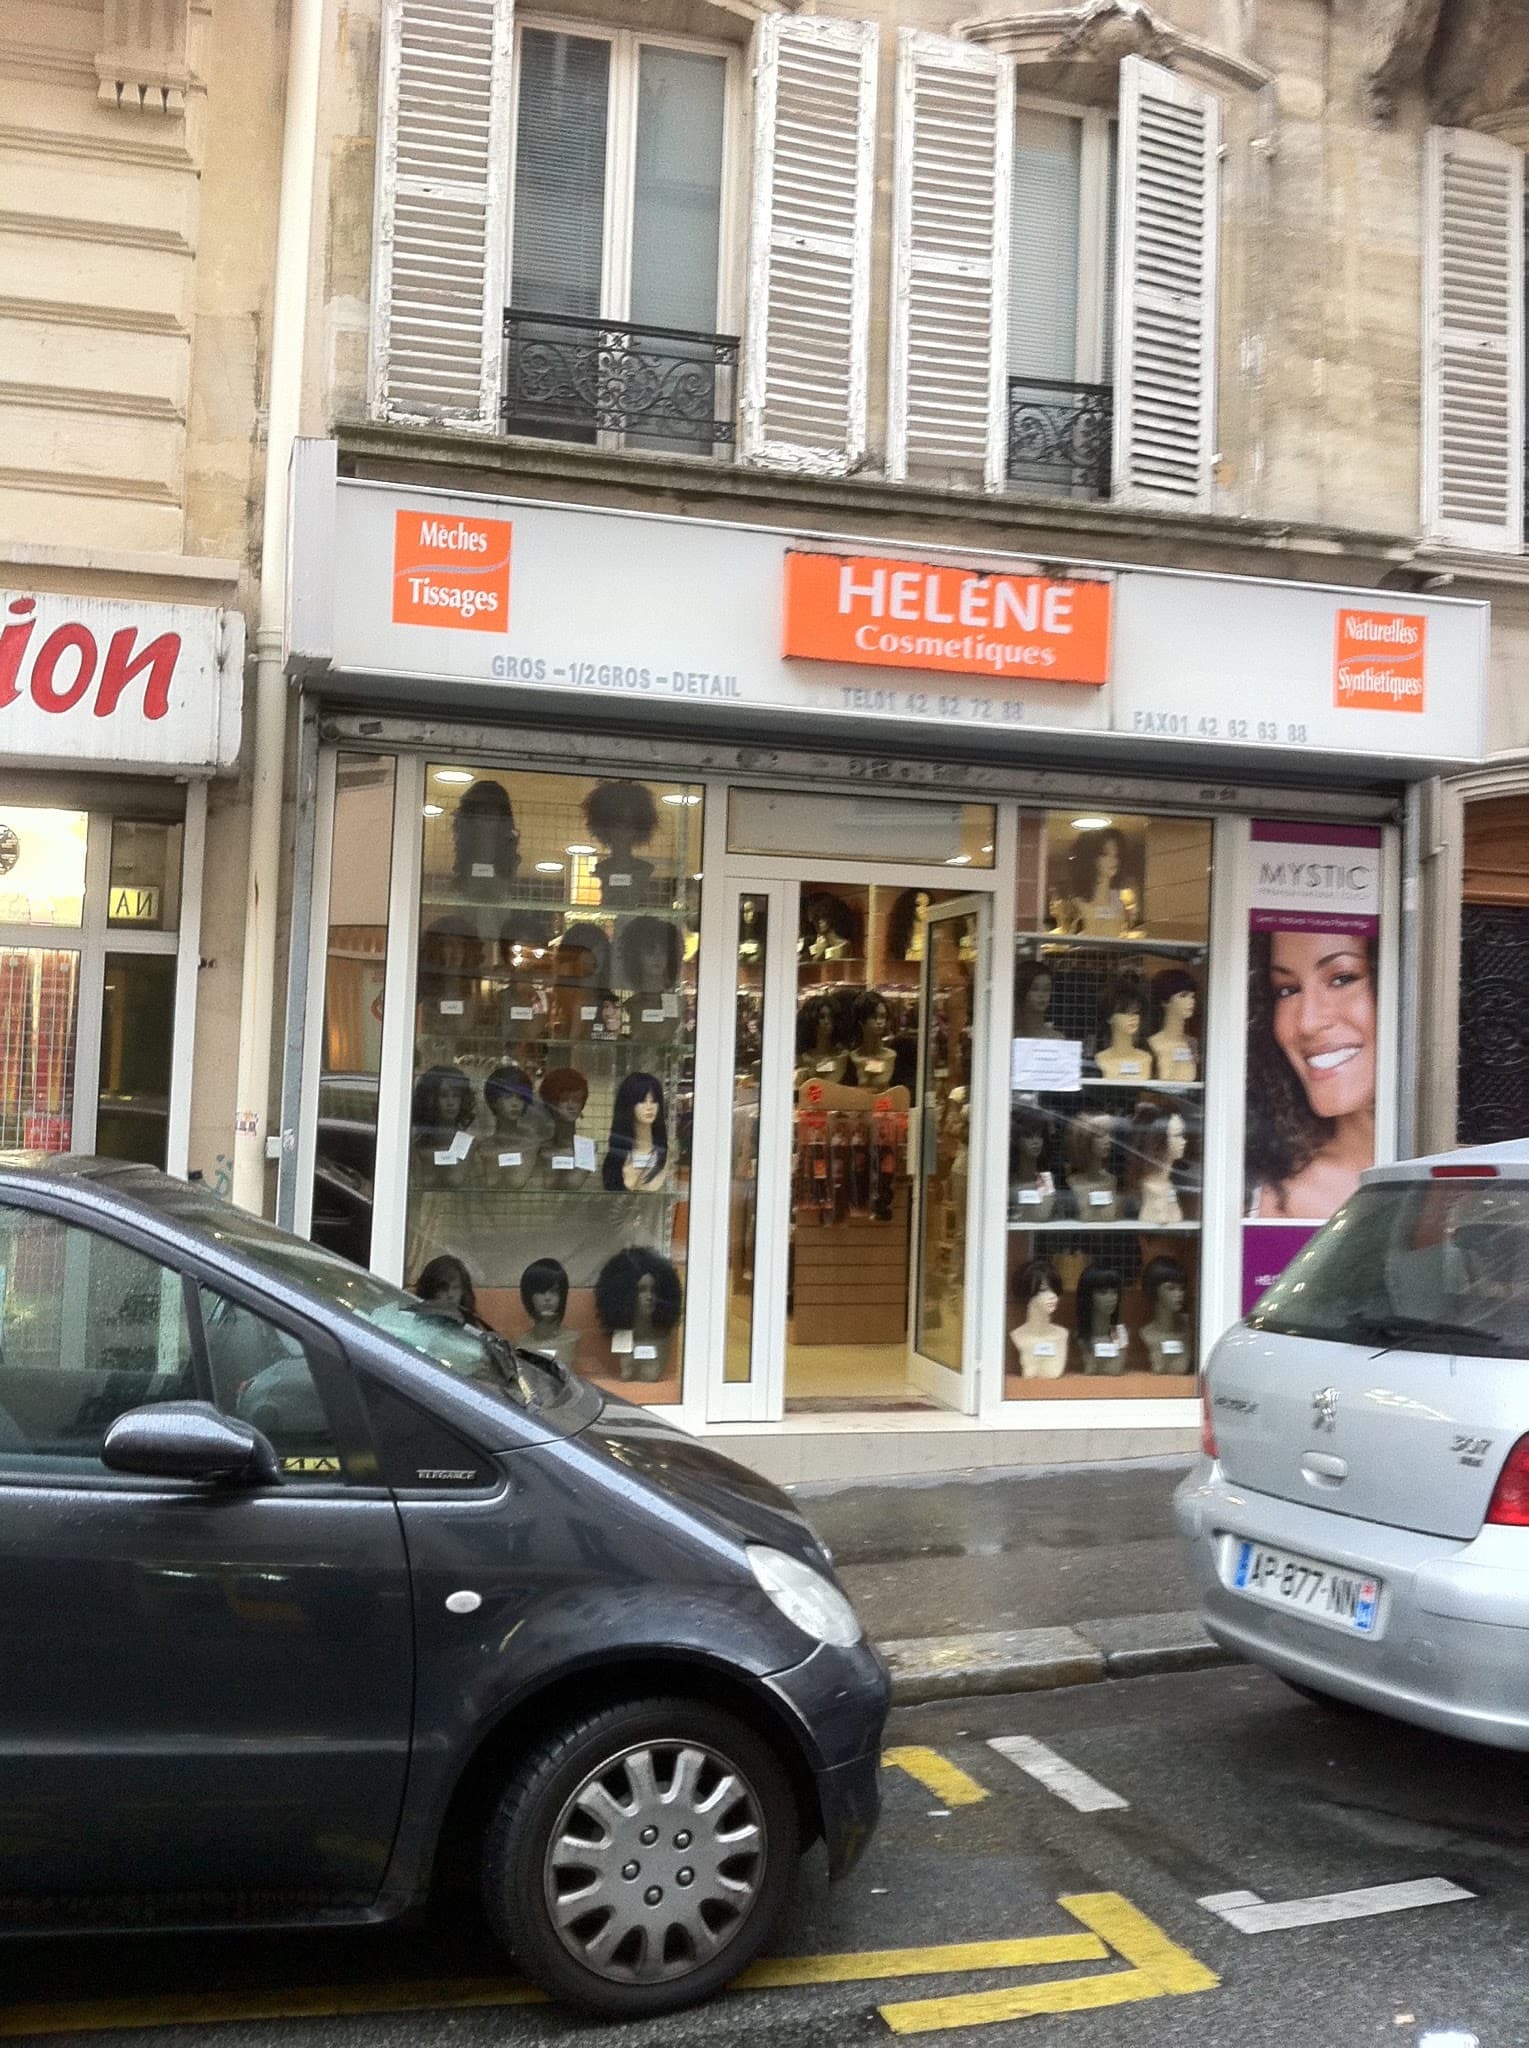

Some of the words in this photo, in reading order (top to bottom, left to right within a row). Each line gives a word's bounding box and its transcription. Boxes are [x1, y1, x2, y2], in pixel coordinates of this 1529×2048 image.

[408, 577, 498, 618] Tissages
[855, 624, 1057, 670] Cosmetiques
[1345, 616, 1418, 644] Naturelles
[492, 655, 546, 680] GROS
[673, 671, 742, 697] DETAIL
[1198, 717, 1218, 737] 42
[1259, 861, 1370, 890] MYSTIC
